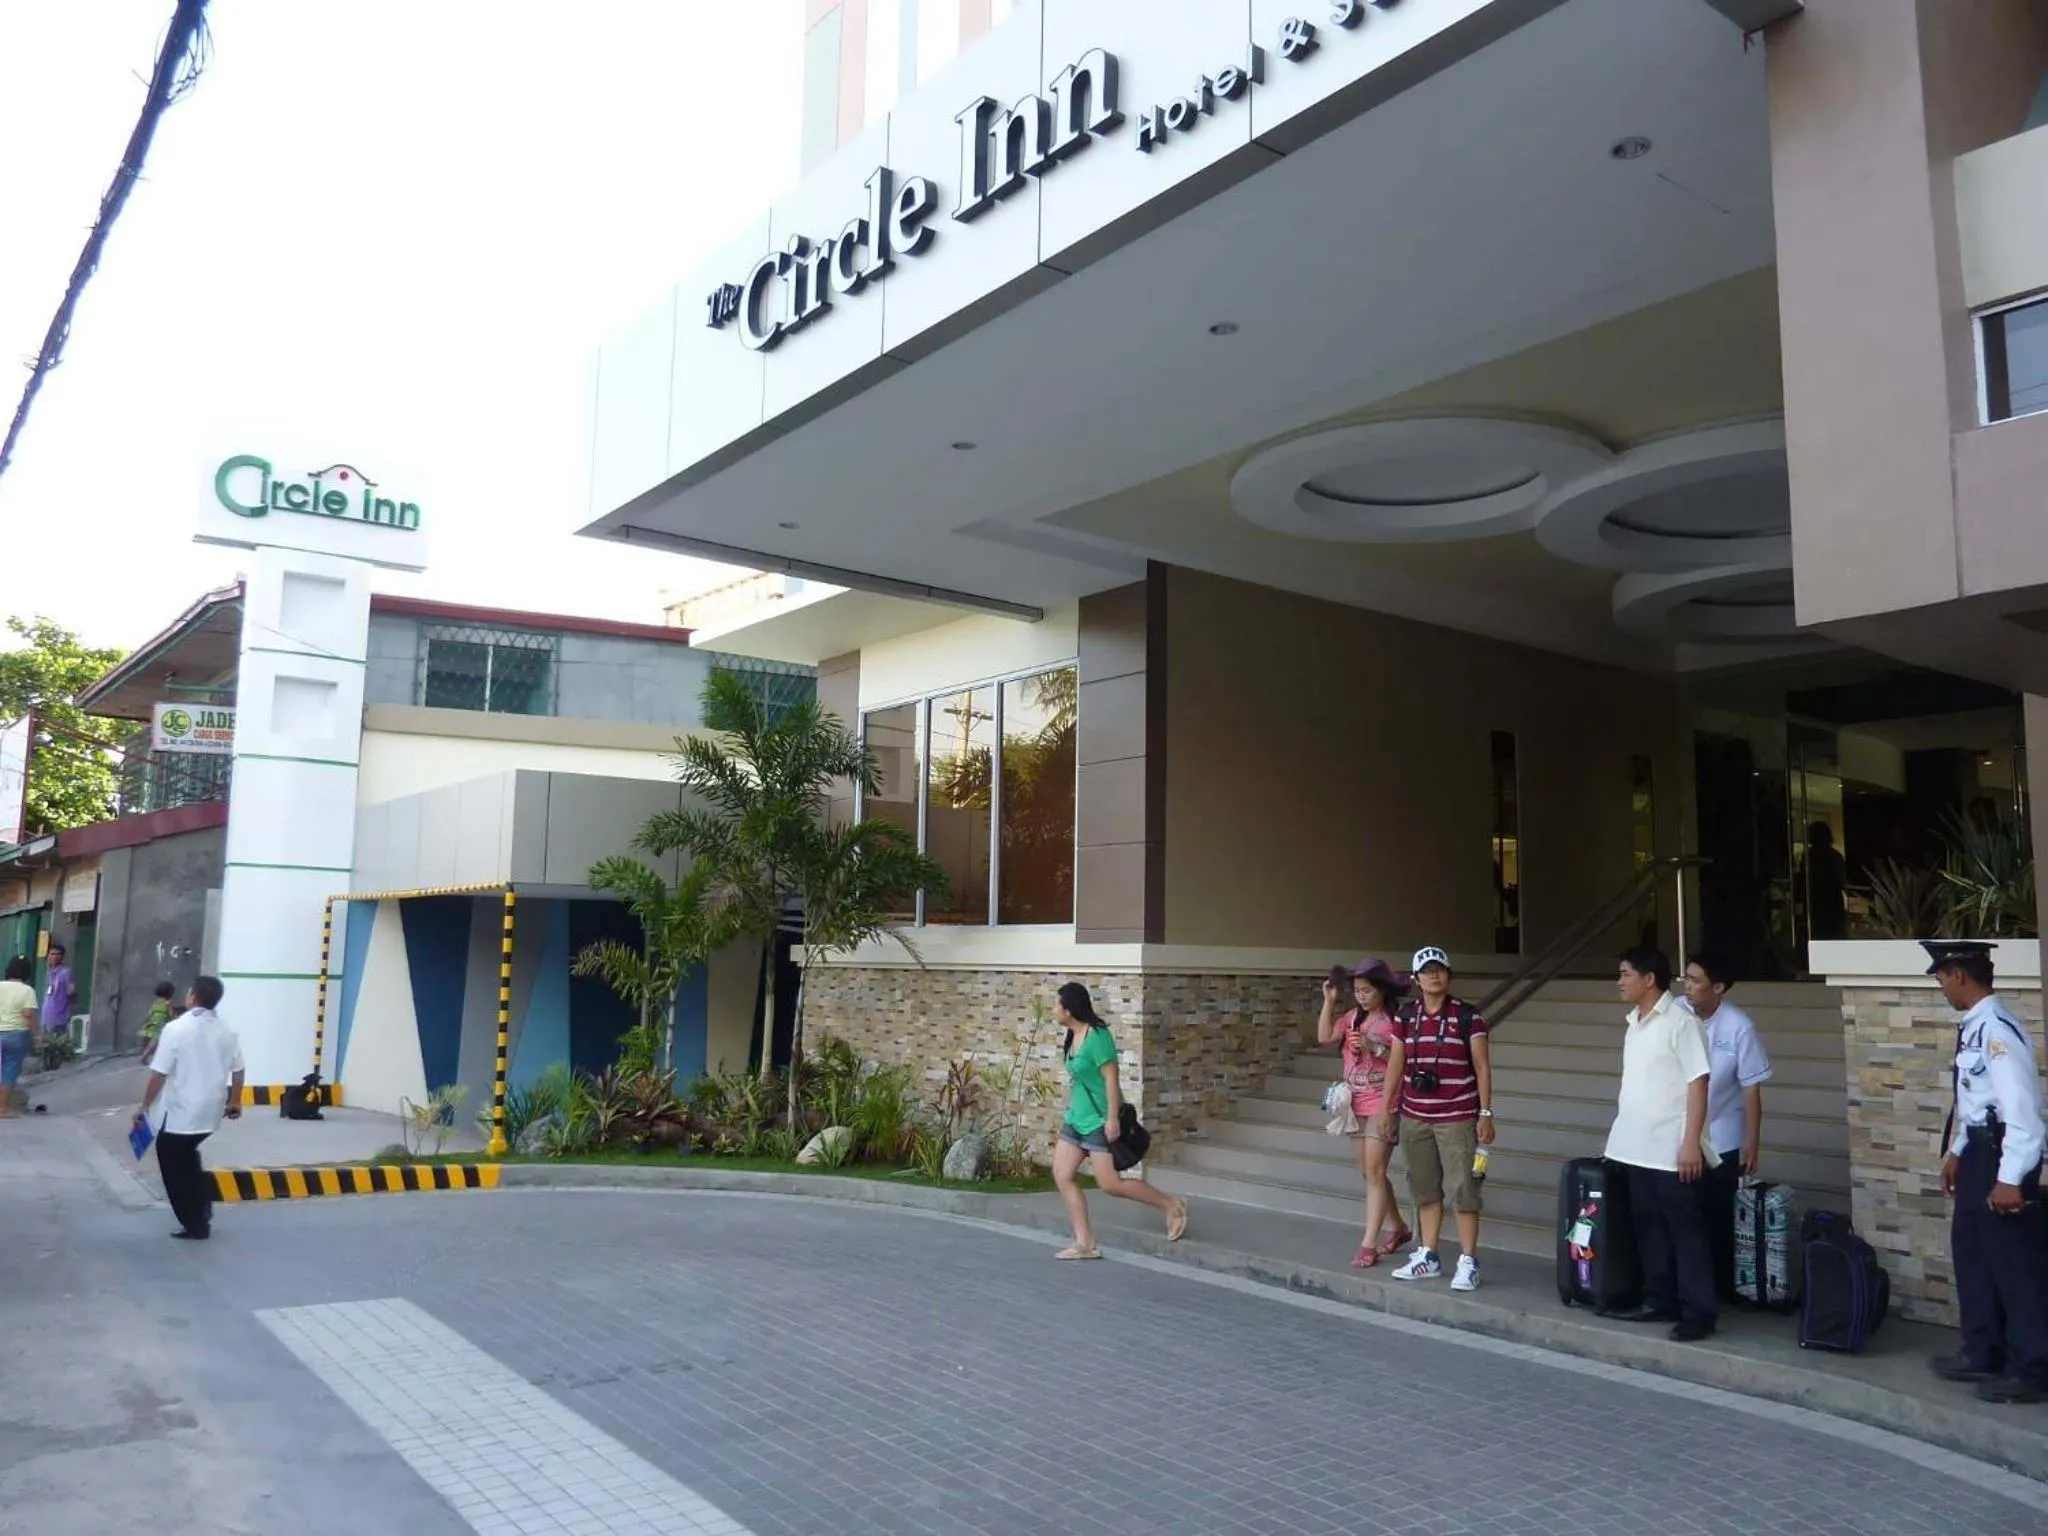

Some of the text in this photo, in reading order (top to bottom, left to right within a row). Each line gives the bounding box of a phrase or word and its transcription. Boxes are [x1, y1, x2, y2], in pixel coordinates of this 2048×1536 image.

[707, 282, 746, 330] The
[738, 165, 938, 352] Circle
[952, 47, 1126, 223] Inn
[1136, 42, 1265, 154] Hotel
[1279, 17, 1320, 63] &
[215, 454, 421, 528] Circle Inn
[195, 711, 236, 729] JADE
